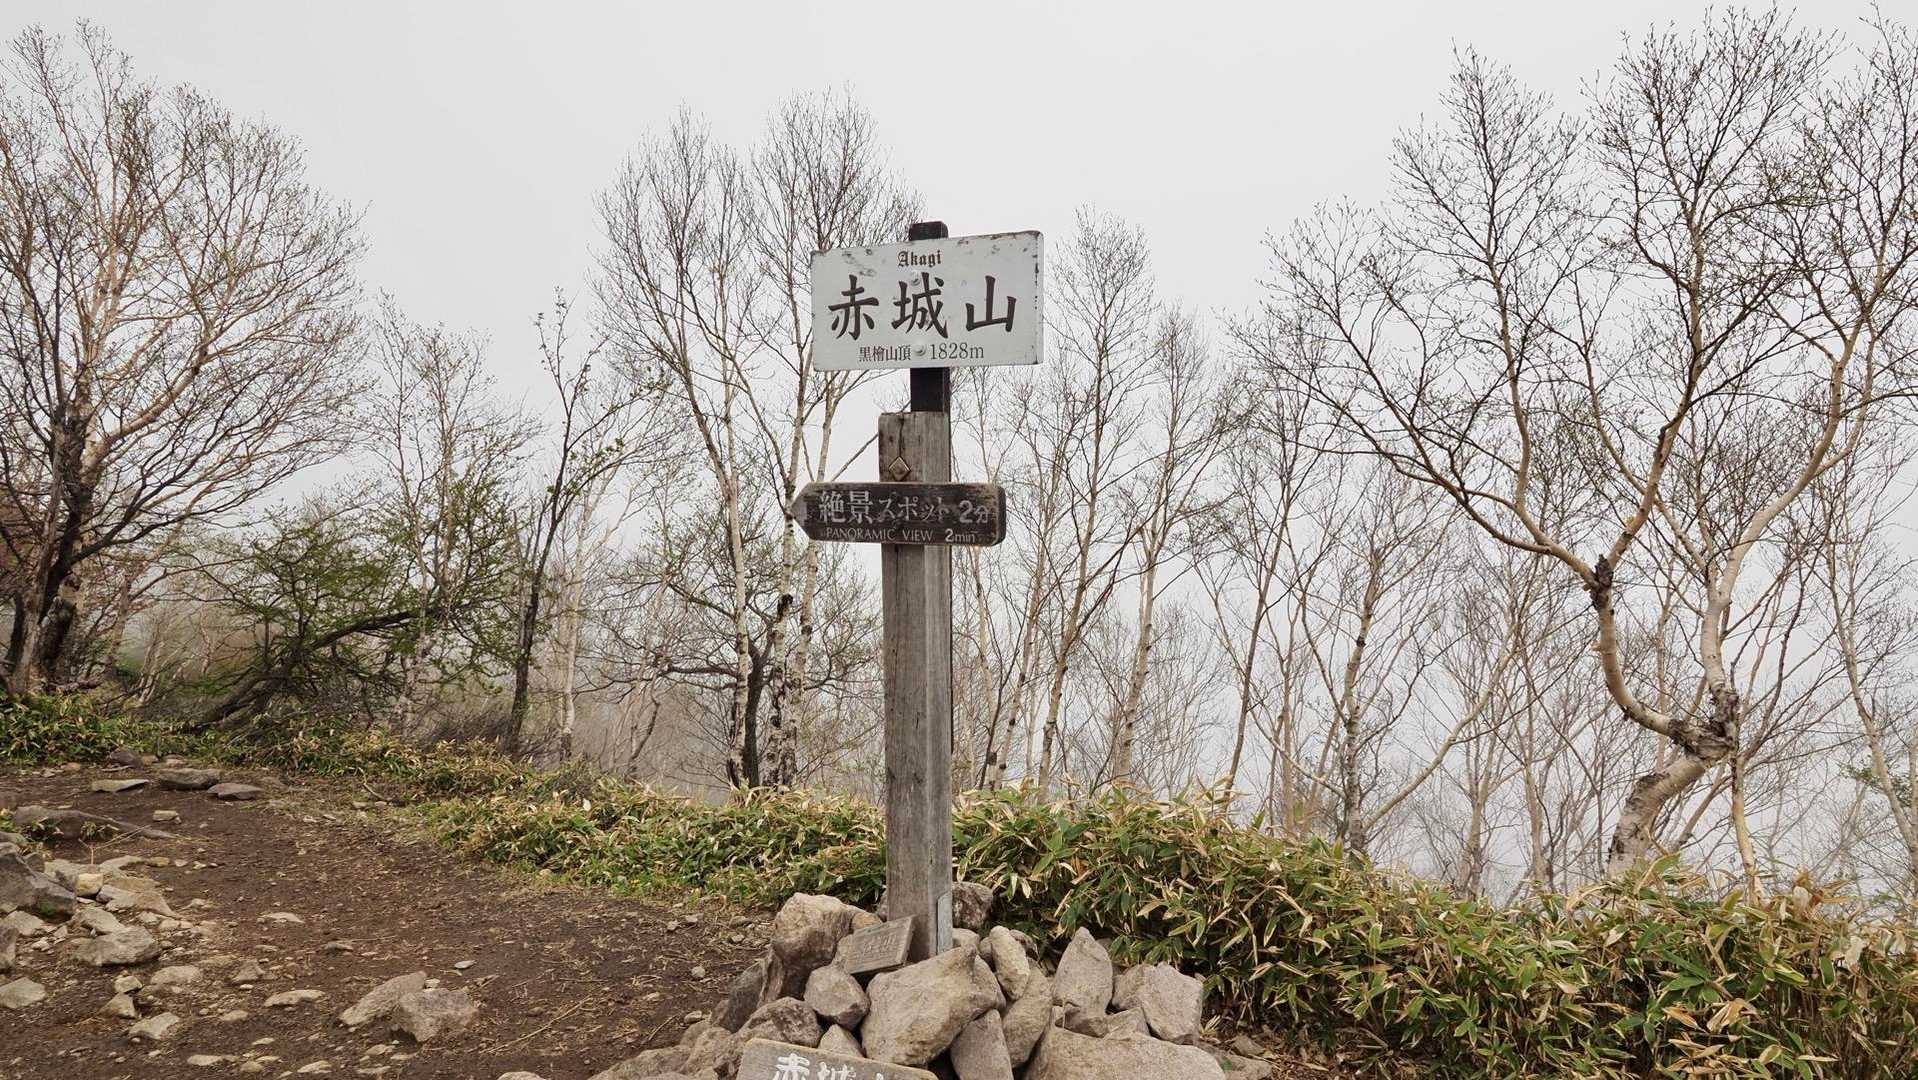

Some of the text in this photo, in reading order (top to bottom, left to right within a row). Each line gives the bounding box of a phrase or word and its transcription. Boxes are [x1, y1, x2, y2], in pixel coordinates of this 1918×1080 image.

[898, 250, 942, 268] Akagi
[828, 272, 1017, 341] 赤城山
[858, 342, 985, 362] 黒檜山頂 1828m
[819, 490, 990, 524] 絶景スポット 2分
[826, 527, 896, 542] PANORAMIC
[902, 529, 934, 541] VIEW
